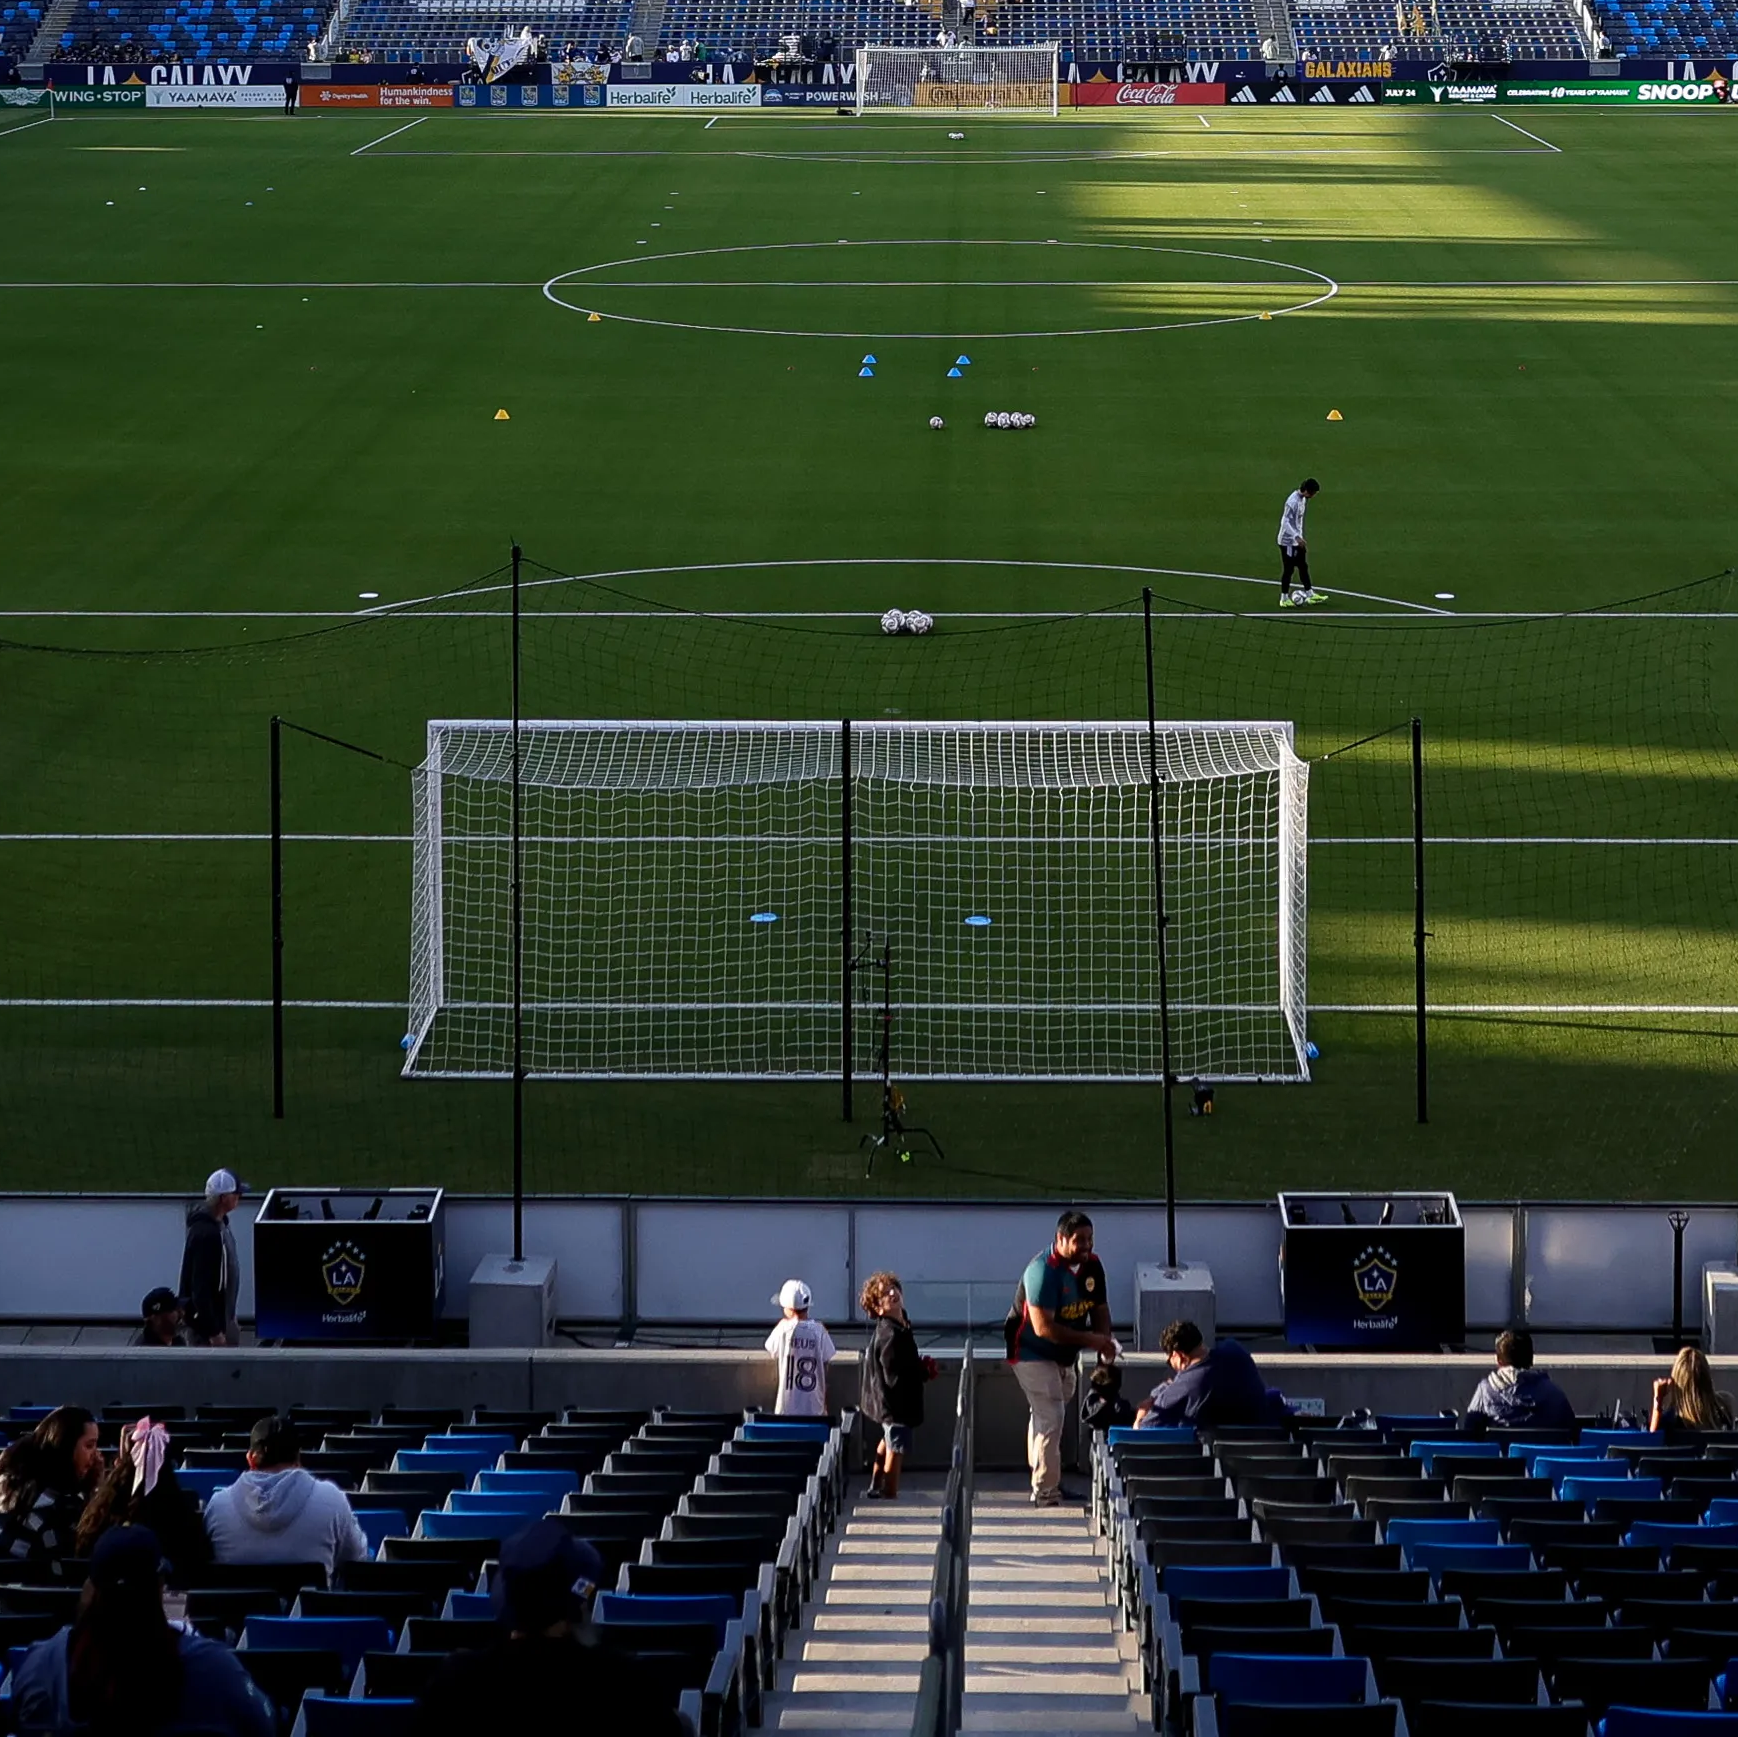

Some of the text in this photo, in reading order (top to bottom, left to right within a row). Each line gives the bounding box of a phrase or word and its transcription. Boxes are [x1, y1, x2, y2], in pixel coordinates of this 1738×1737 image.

[380, 87, 453, 97] Humankindness
[611, 88, 671, 104] Herbalife
[691, 88, 751, 104] Herbalife
[1116, 83, 1178, 104] Coca-Cola
[1447, 85, 1498, 94] YAAMAVA'
[1637, 84, 1713, 100] SNOOP
[54, 91, 142, 102] WING STOP
[169, 91, 237, 103] YAAMAVA'
[380, 96, 431, 105] for the win.
[806, 92, 878, 102] POWERWSH
[333, 1272, 356, 1286] LA
[1364, 1277, 1388, 1291] LA
[1353, 1319, 1394, 1329] Herbalife
[786, 1354, 817, 1393] 18
